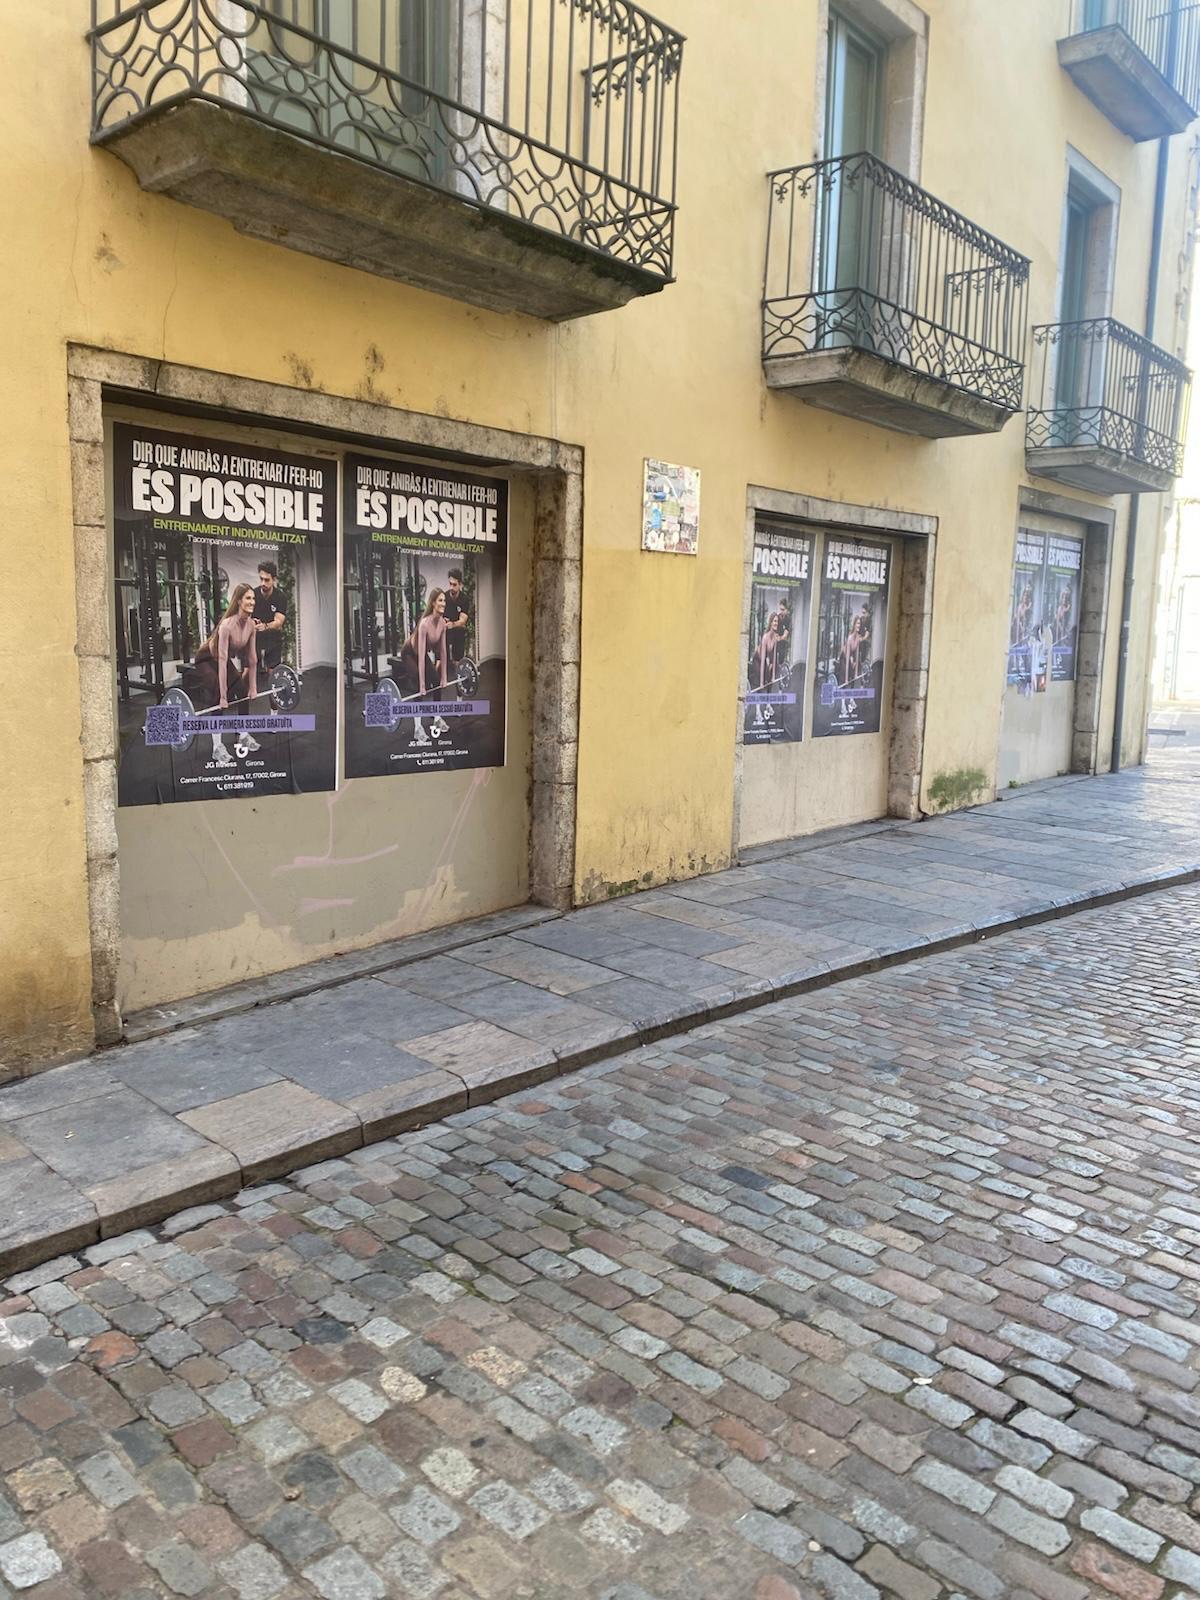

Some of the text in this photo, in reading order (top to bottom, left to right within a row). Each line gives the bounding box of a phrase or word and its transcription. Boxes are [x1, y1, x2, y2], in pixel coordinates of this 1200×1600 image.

[132, 439, 323, 489] DIR QUE ANIRÀS A ENTRENAR I FER-HO
[132, 460, 324, 532] ÉS POSSIBLE
[356, 465, 497, 505] DIR QUE ANIRÀS A ENTRENAR I FER-HO
[356, 485, 498, 543] ÉS POSSIBLE
[153, 518, 307, 545] ENTRENAMENT INDIVIDUALITZAT
[371, 532, 485, 553] ENTRENAMENT INDIVIDUALITZAT
[753, 547, 809, 579] POSSIBLE
[840, 556, 887, 585] POSSIBLE
[183, 720, 210, 731] RESERVA
[210, 720, 218, 730] LA
[219, 719, 245, 730] PRIMERA
[245, 717, 266, 729] SESSIÓ
[198, 775, 223, 783] Francesc
[204, 761, 215, 769] JG
